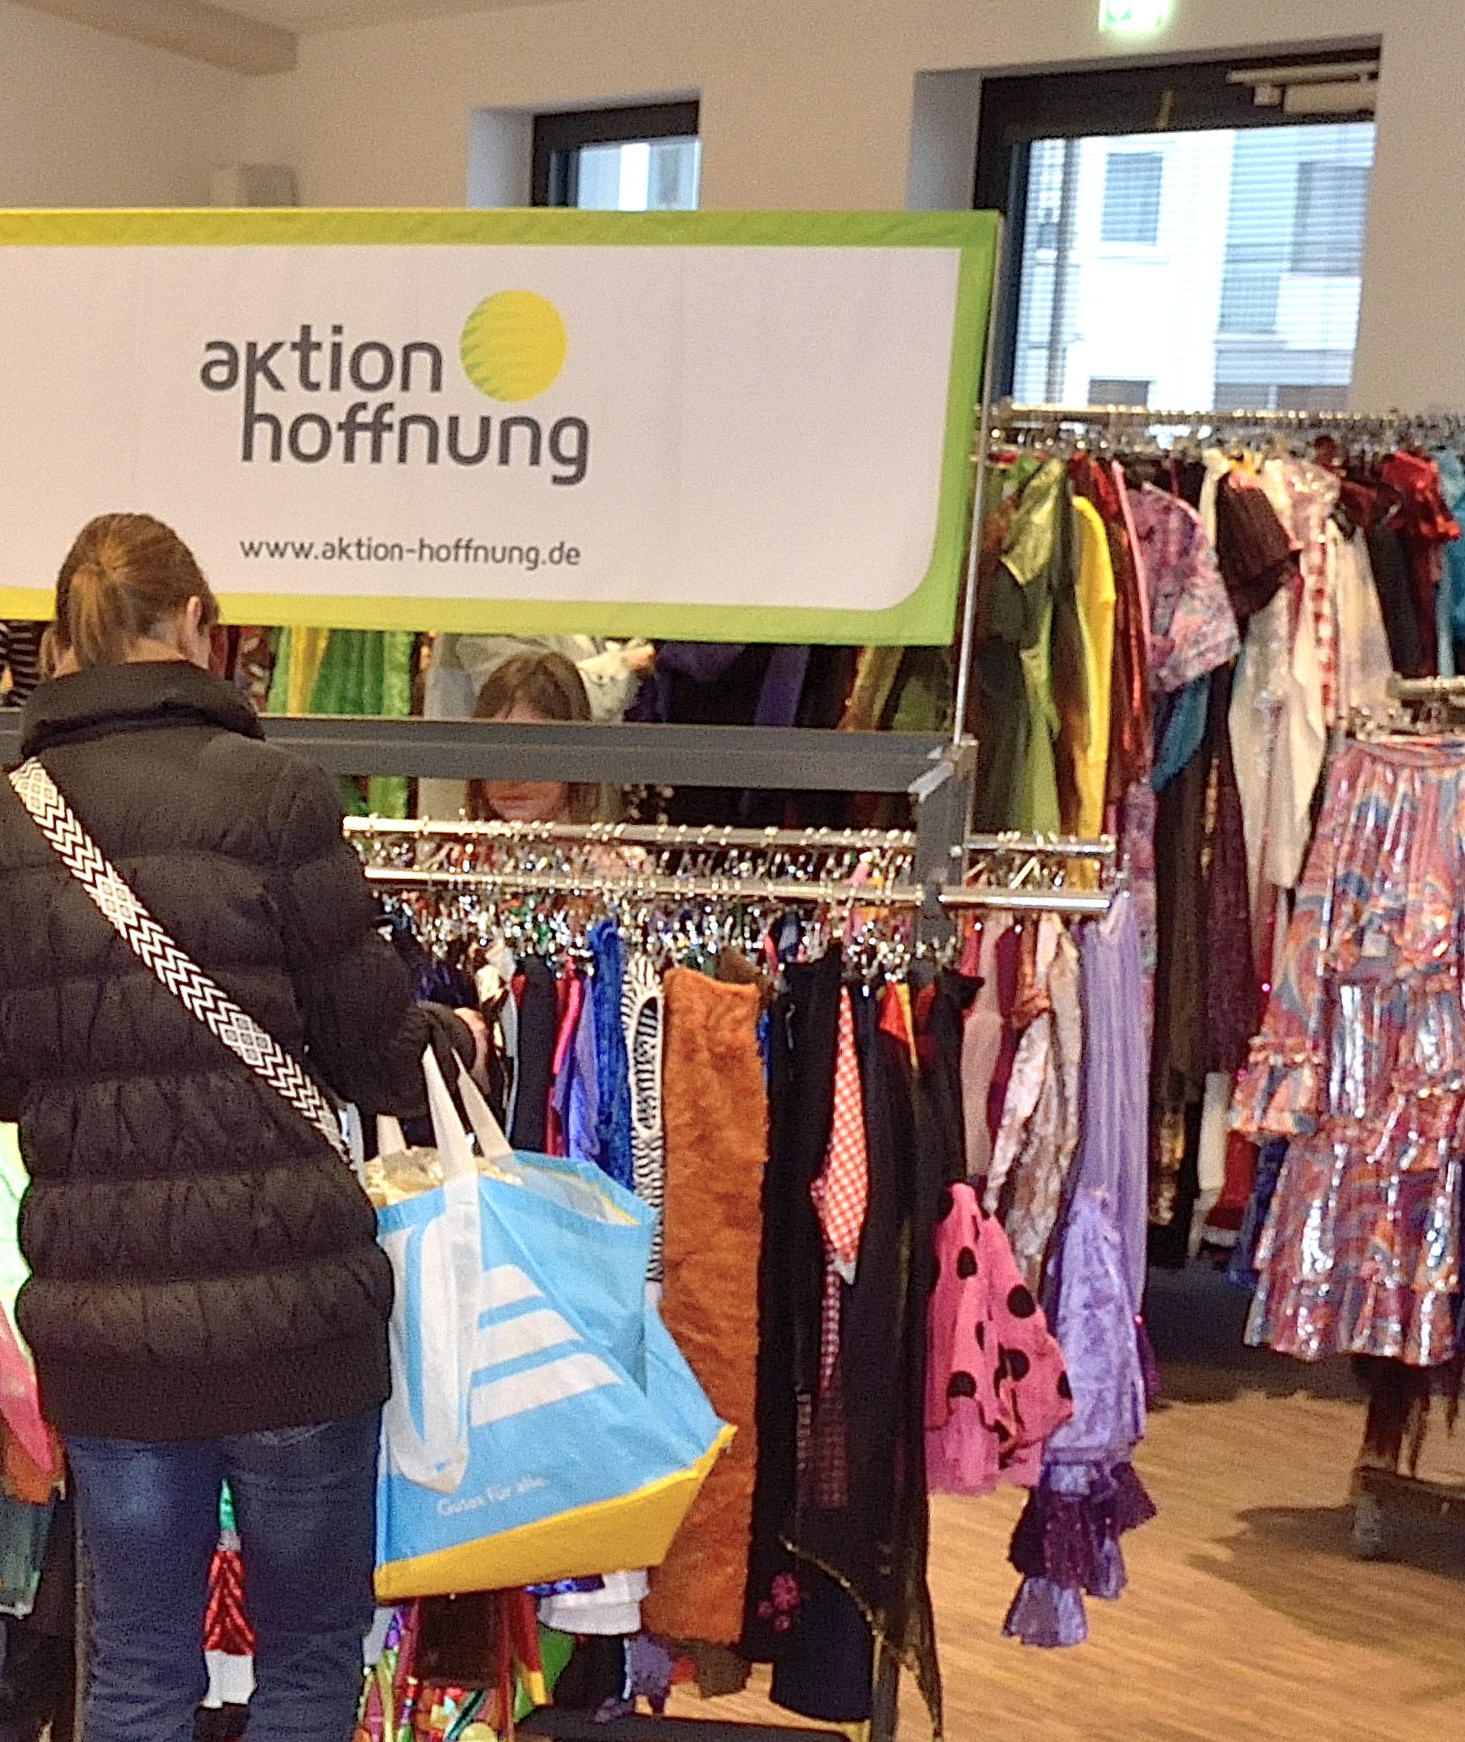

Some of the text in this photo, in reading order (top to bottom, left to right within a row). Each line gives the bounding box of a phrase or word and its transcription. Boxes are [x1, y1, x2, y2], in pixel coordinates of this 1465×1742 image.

[200, 324, 444, 393] aktion
[241, 398, 590, 486] hoffnung
[240, 537, 582, 571] www.aktion-hoffnung.de
